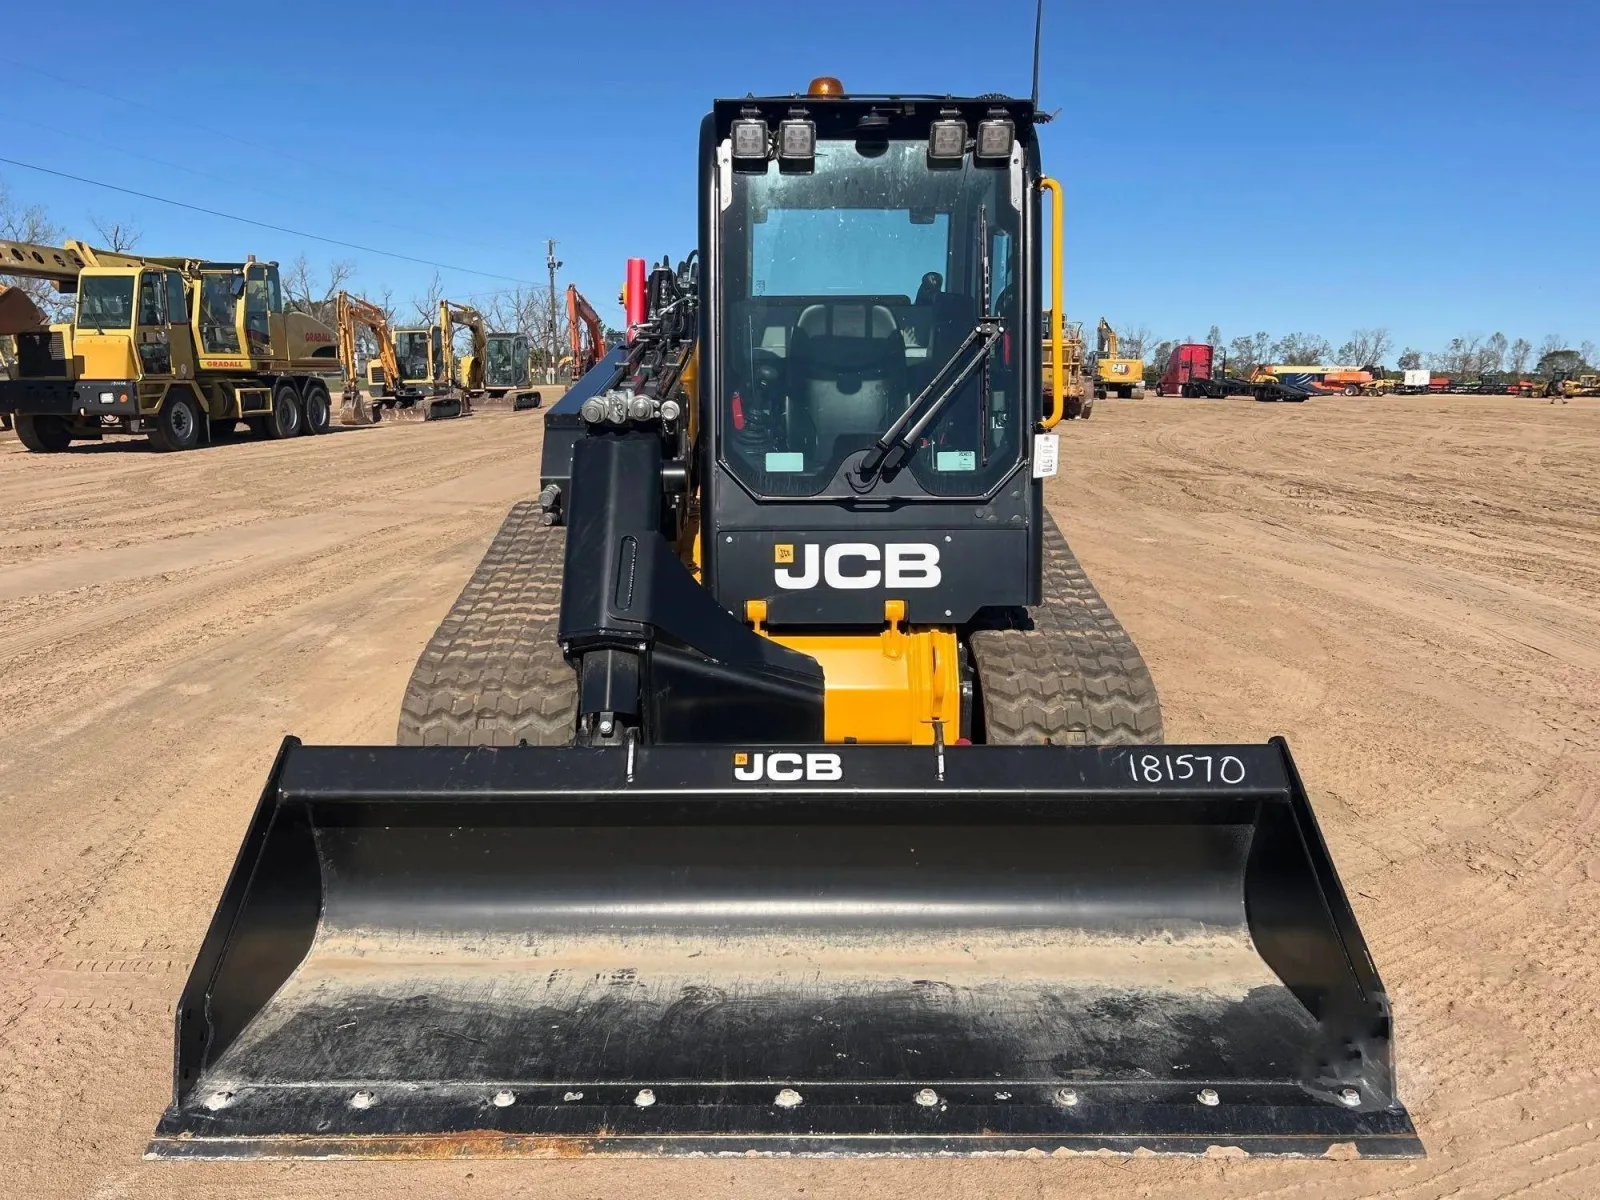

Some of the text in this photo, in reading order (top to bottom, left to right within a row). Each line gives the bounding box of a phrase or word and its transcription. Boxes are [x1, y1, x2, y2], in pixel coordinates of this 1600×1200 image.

[305, 332, 331, 342] GRADALL
[1111, 363, 1127, 373] CAT
[774, 543, 942, 590] JCB
[734, 753, 843, 781] JCB
[1130, 754, 1246, 784] 181570
